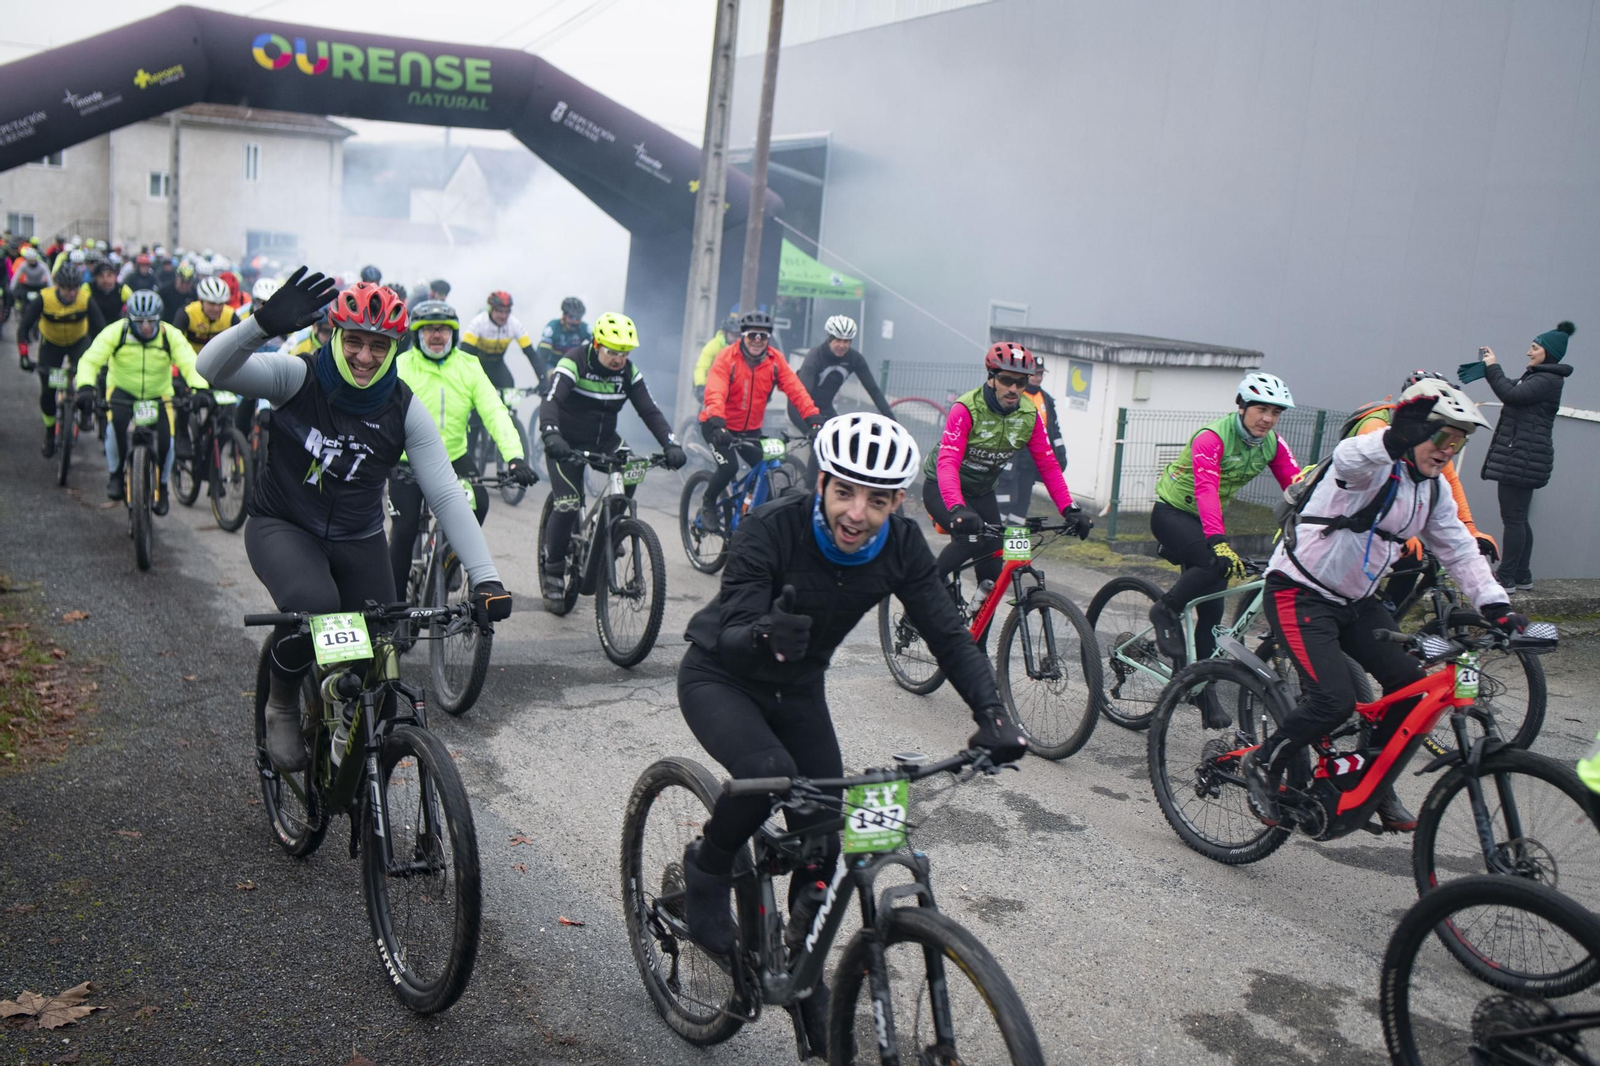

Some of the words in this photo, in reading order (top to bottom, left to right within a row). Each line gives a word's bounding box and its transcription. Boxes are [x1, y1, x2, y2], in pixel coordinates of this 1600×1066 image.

[252, 32, 493, 93] OURENSE
[408, 91, 490, 112] NATURAL
[1009, 540, 1029, 549] 100
[323, 630, 360, 646] 161
[857, 808, 900, 829] 147
[376, 937, 401, 985] MAXXIS
